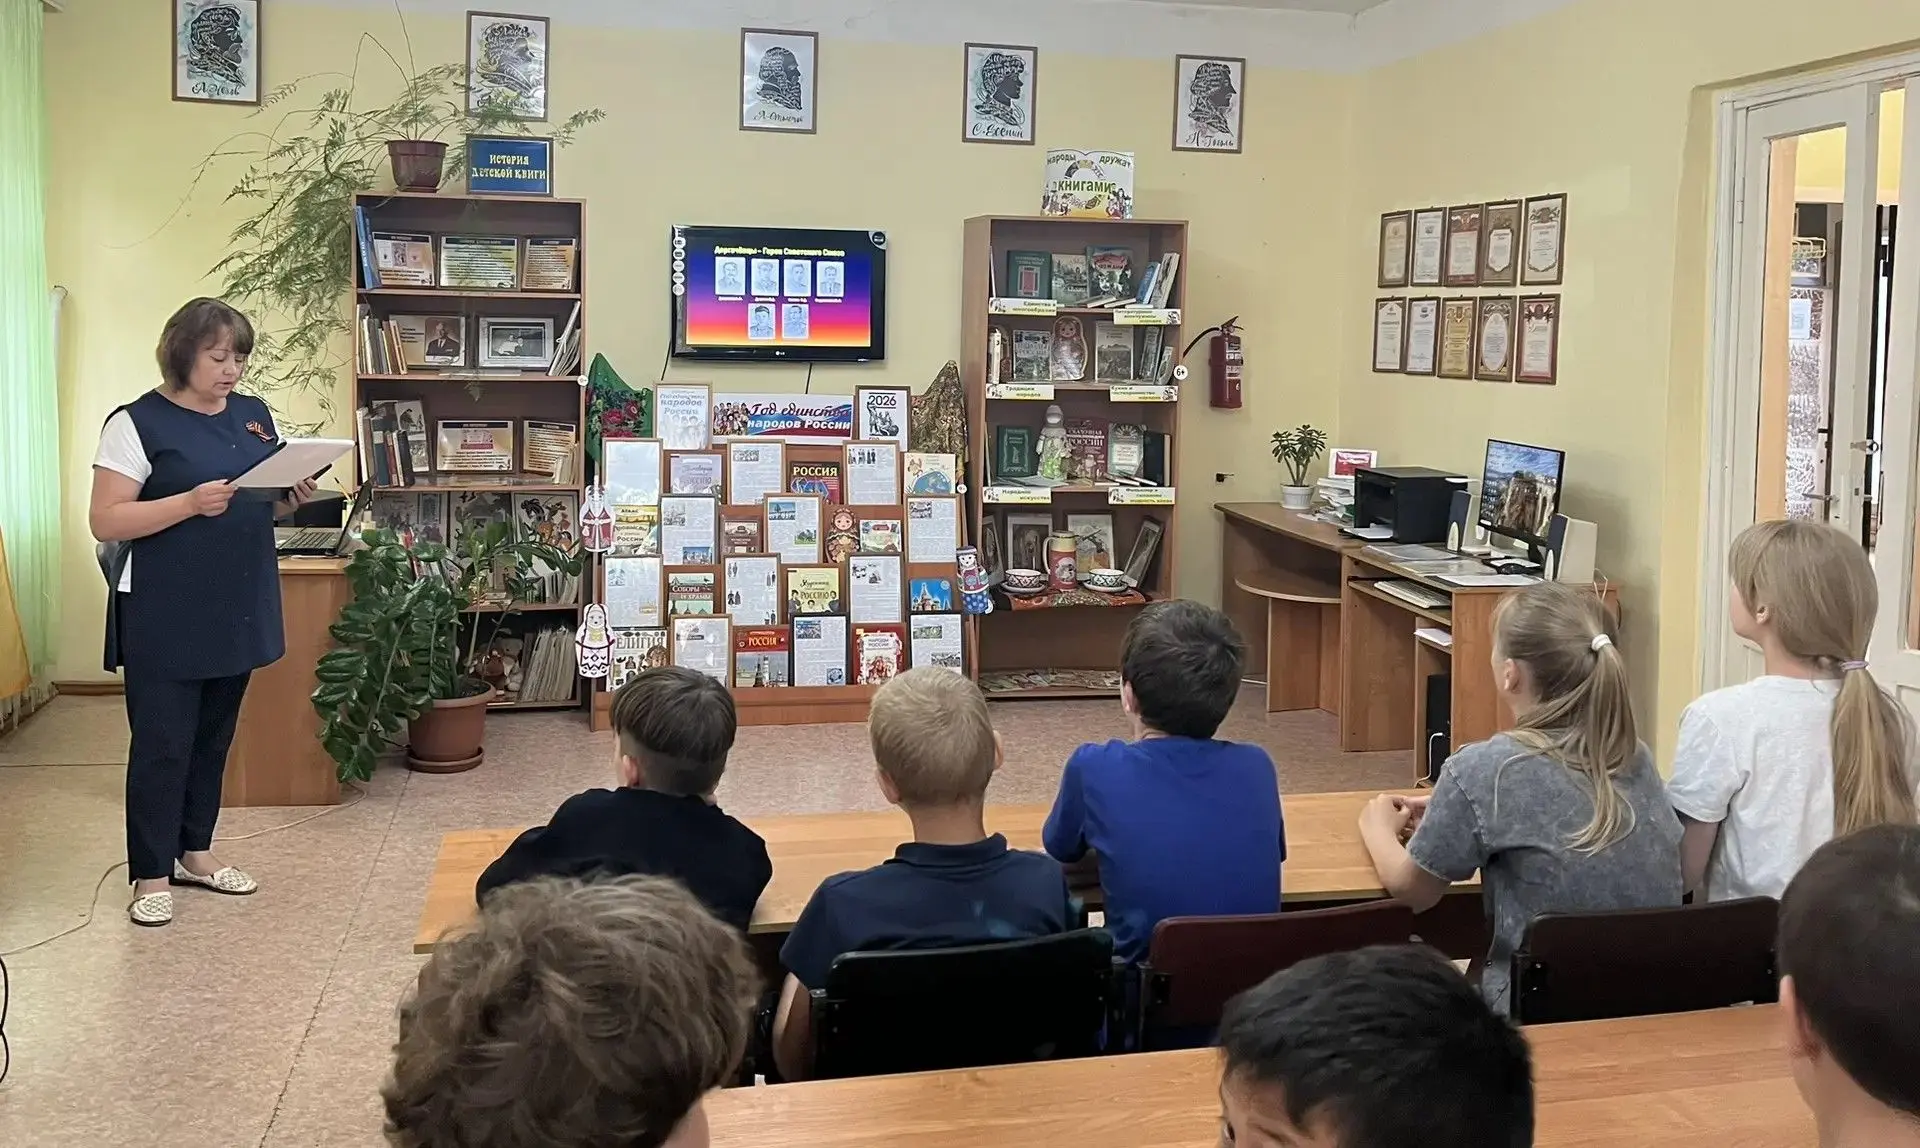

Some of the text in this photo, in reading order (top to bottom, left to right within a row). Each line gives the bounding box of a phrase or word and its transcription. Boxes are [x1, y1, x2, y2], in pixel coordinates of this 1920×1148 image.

[489, 154, 529, 165] ИСТОРИЯ
[1099, 155, 1131, 168] дружат
[472, 167, 546, 179] ДЕТСКОЙ КНИГИ
[1058, 180, 1113, 194] книгами
[868, 395, 897, 406] 2026
[749, 402, 849, 417] Год единства
[747, 419, 851, 430] народов России
[793, 466, 838, 477] РОССИЯ
